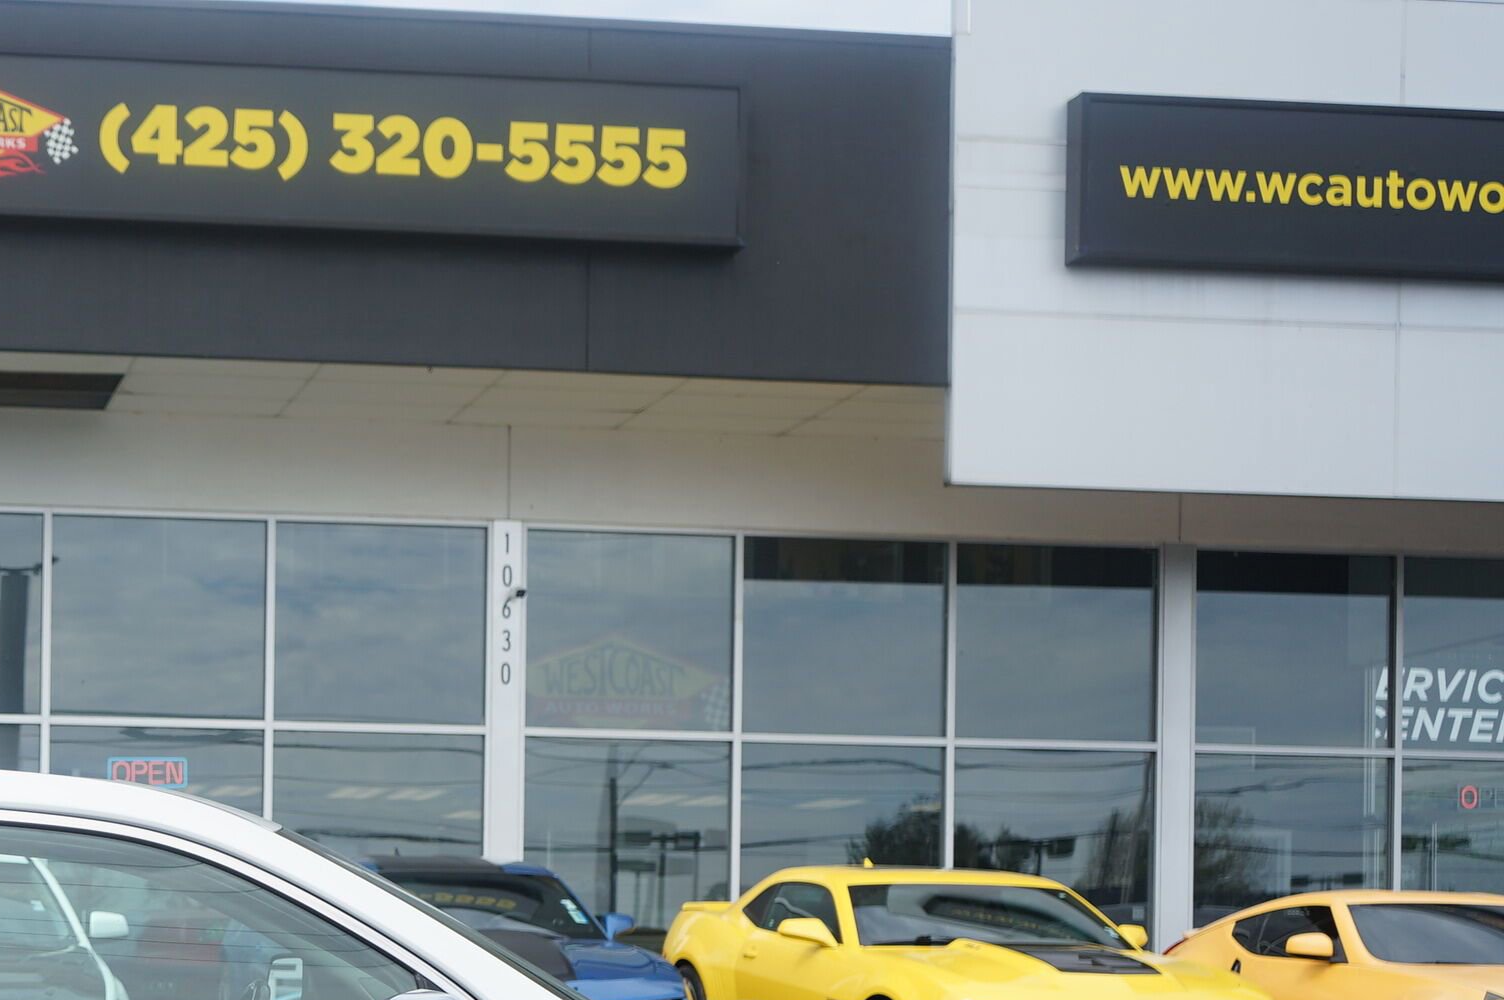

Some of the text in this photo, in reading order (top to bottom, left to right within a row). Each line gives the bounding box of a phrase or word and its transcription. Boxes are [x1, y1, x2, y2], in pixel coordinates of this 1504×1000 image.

[99, 102, 688, 189] (425) 320-5555
[1119, 163, 1504, 215] www.wcautowo
[112, 760, 184, 785] OPEN
